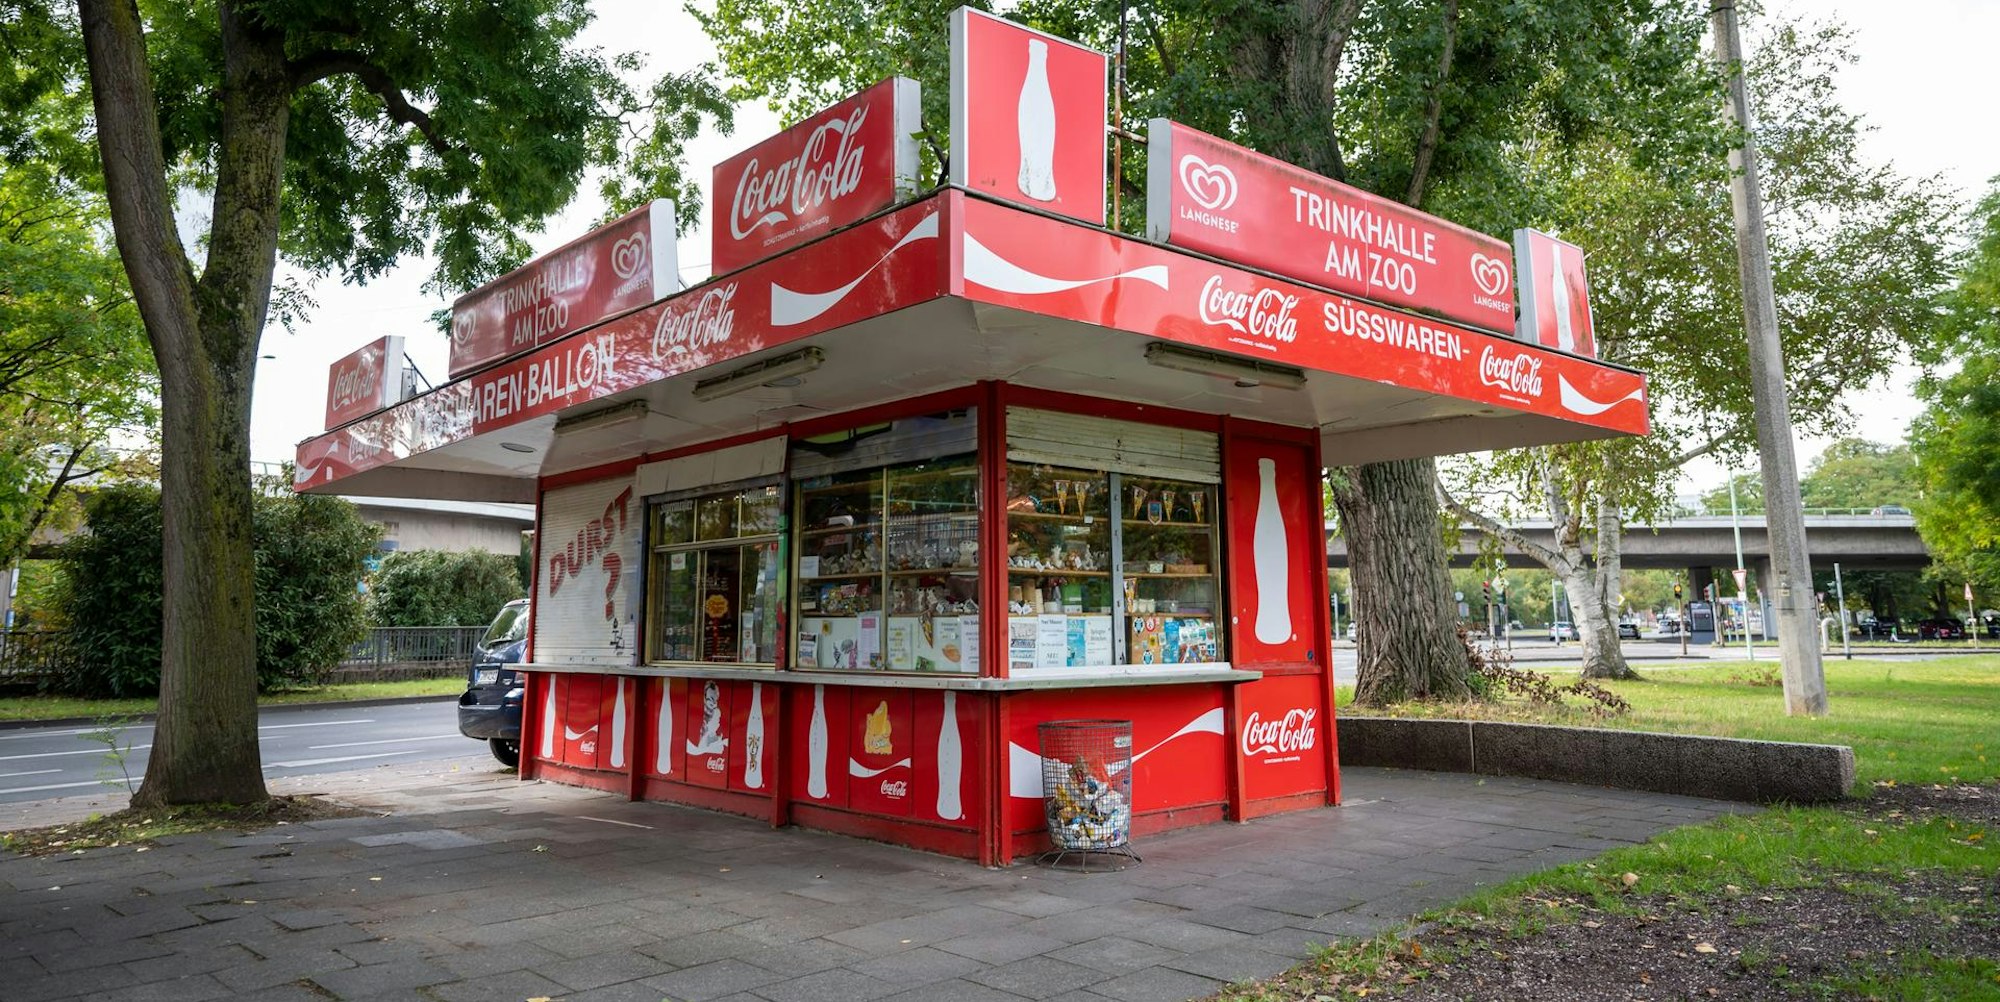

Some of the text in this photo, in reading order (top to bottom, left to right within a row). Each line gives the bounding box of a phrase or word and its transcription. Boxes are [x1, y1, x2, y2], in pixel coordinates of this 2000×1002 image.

[731, 103, 870, 241] Coca-Cola
[1180, 205, 1238, 233] LANGNESE
[1290, 186, 1437, 265] TRINKHALLE
[499, 254, 584, 316] TRINKHALLE
[1324, 241, 1416, 296] AM ZOO
[512, 299, 569, 347] AM ZOO
[652, 281, 739, 362] Coca-Cola
[1199, 275, 1299, 343] Coca-Cola
[1324, 299, 1470, 361] SÜSSWAREN-
[1473, 293, 1511, 312] LANGNESE
[1480, 345, 1542, 397] Coca-Cola
[549, 484, 633, 598] DURST
[1242, 708, 1317, 756] Coca-Cola
